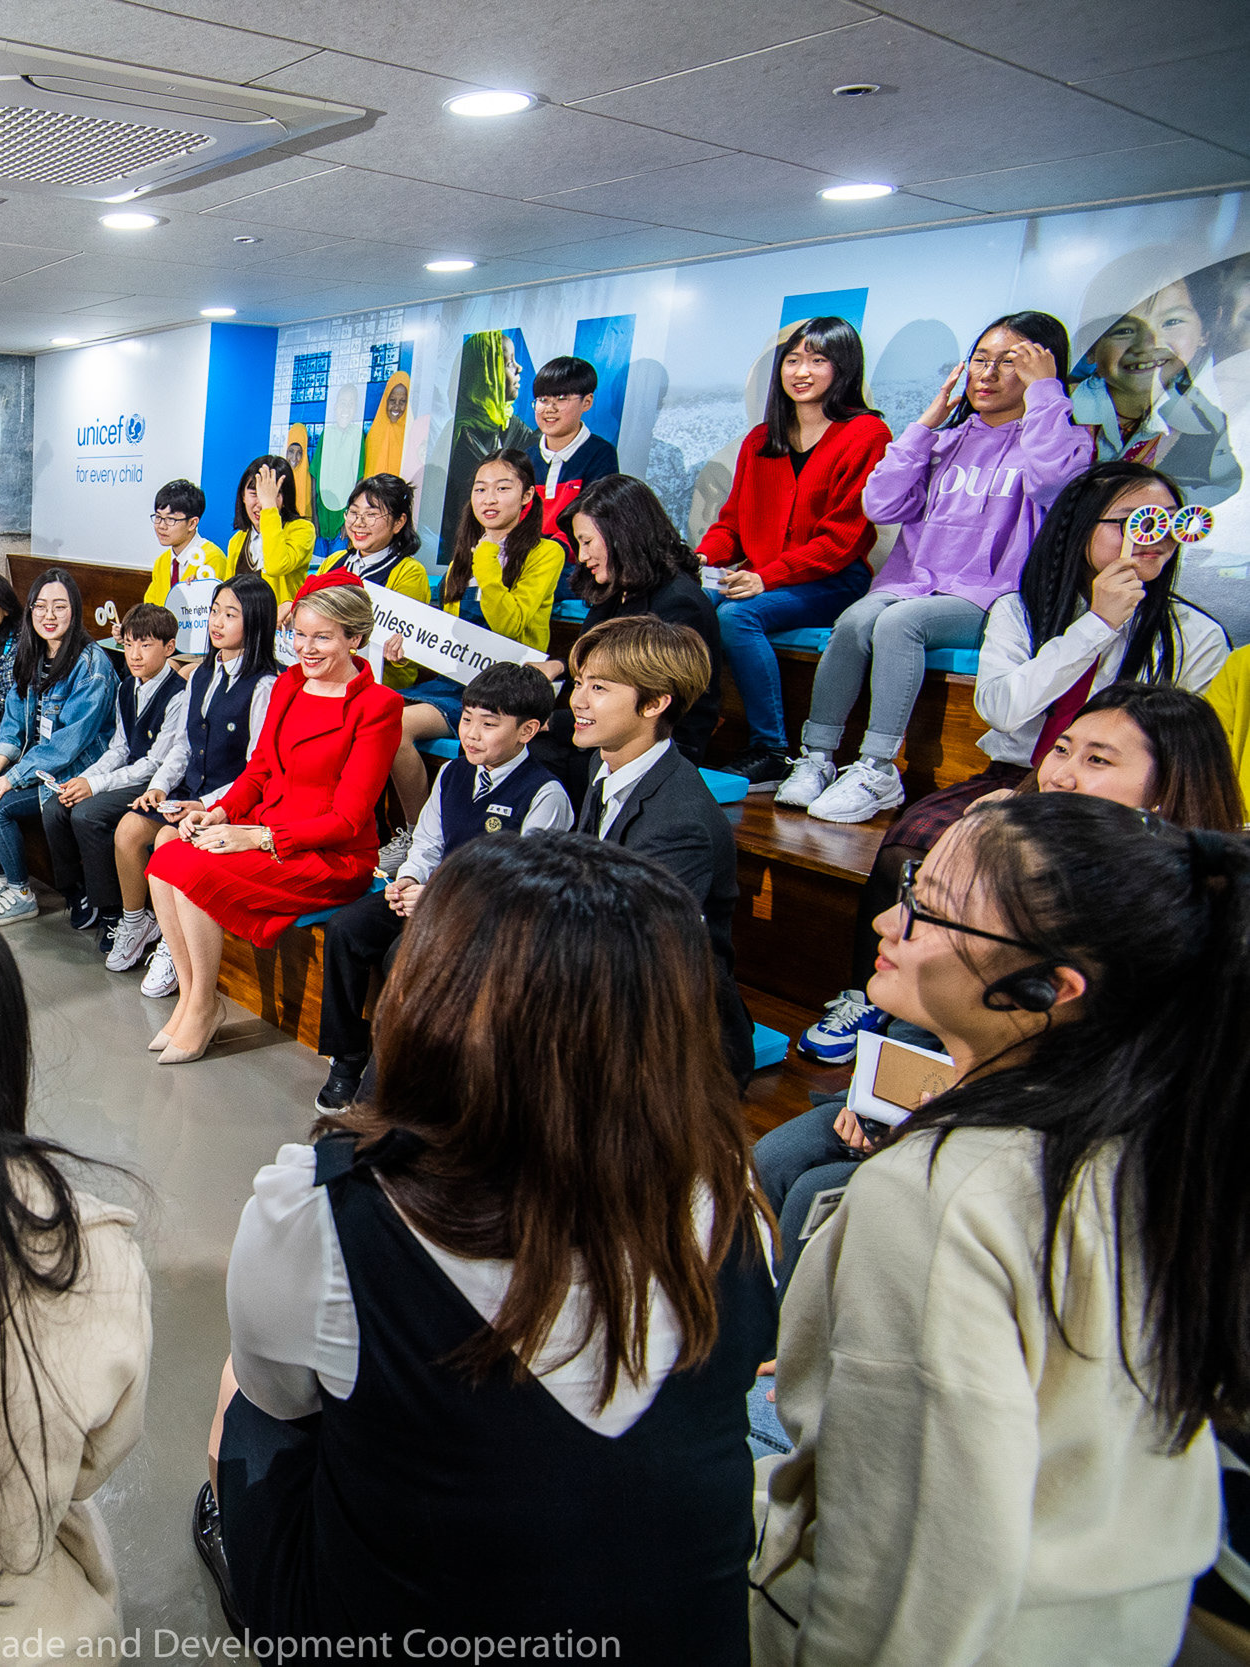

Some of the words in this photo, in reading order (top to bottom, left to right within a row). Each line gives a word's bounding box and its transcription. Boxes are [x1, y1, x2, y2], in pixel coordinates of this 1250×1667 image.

[77, 415, 124, 446] unicef
[76, 465, 89, 482] for
[90, 469, 117, 487] every
[119, 464, 143, 482] child
[181, 606, 192, 615] The
[193, 605, 208, 616] right
[416, 628, 439, 649] we
[440, 639, 469, 663] act
[468, 651, 497, 671] no
